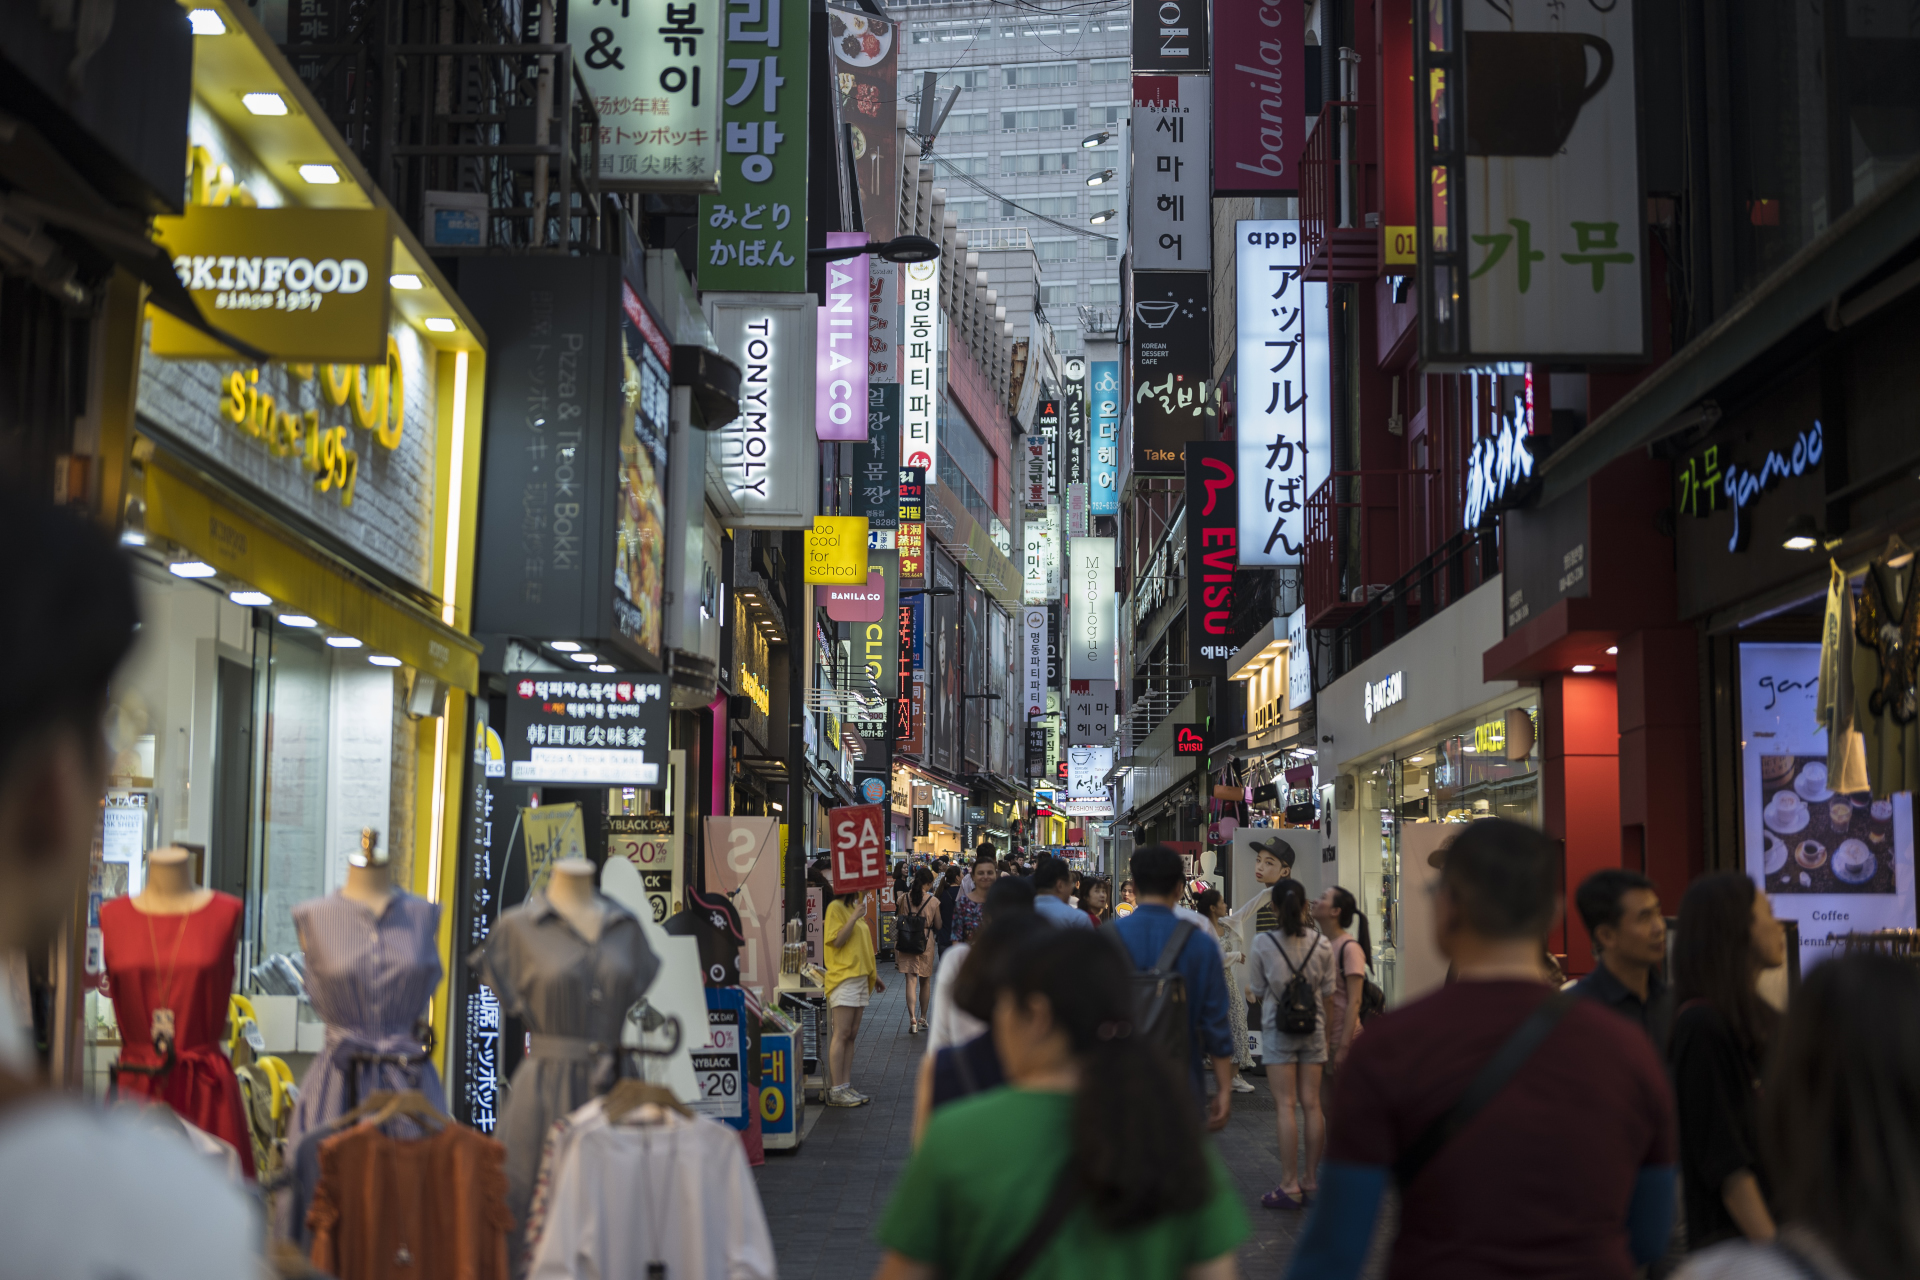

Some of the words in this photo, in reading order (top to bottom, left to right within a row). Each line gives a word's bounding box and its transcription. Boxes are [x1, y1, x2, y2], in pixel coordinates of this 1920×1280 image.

[1258, 0, 1282, 27] c
[584, 27, 626, 70] &
[725, 0, 786, 183] 리가방
[1135, 99, 1177, 107] HAIR
[1235, 38, 1284, 177] banila
[1156, 116, 1184, 261] 세마헤어
[709, 203, 792, 231] みどり
[709, 239, 797, 268] かばん
[1469, 218, 1636, 294] 가무
[175, 258, 368, 295] SKINFOOD
[1141, 342, 1167, 350] KOREAN
[557, 332, 584, 398] Pizza
[909, 287, 931, 444] 명동파티파티
[745, 318, 769, 497] TONYMOLY
[829, 379, 853, 425] CO
[1040, 416, 1058, 424] HAIR
[1097, 400, 1118, 492] 오다헤어
[1144, 449, 1176, 461] Take
[1679, 443, 1722, 518] 가무
[552, 502, 580, 570] Bokki
[809, 533, 841, 547] cool
[809, 549, 829, 562] for
[902, 559, 918, 572] 3F
[1027, 541, 1042, 580] 아미소
[809, 563, 857, 577] school
[1202, 527, 1237, 635] EVISU
[831, 592, 866, 601] BANILA
[866, 593, 881, 601] CO
[1085, 556, 1100, 662] Monologue
[1030, 632, 1041, 703] 명동파티파티
[1077, 703, 1109, 716] 세마
[526, 723, 648, 747] 韩国顶尖味家
[1077, 723, 1107, 736] 헤어
[1178, 741, 1203, 752] EVISU
[650, 820, 670, 830] DAY
[1812, 911, 1850, 921] Coffee
[1798, 936, 1831, 947] ienna
